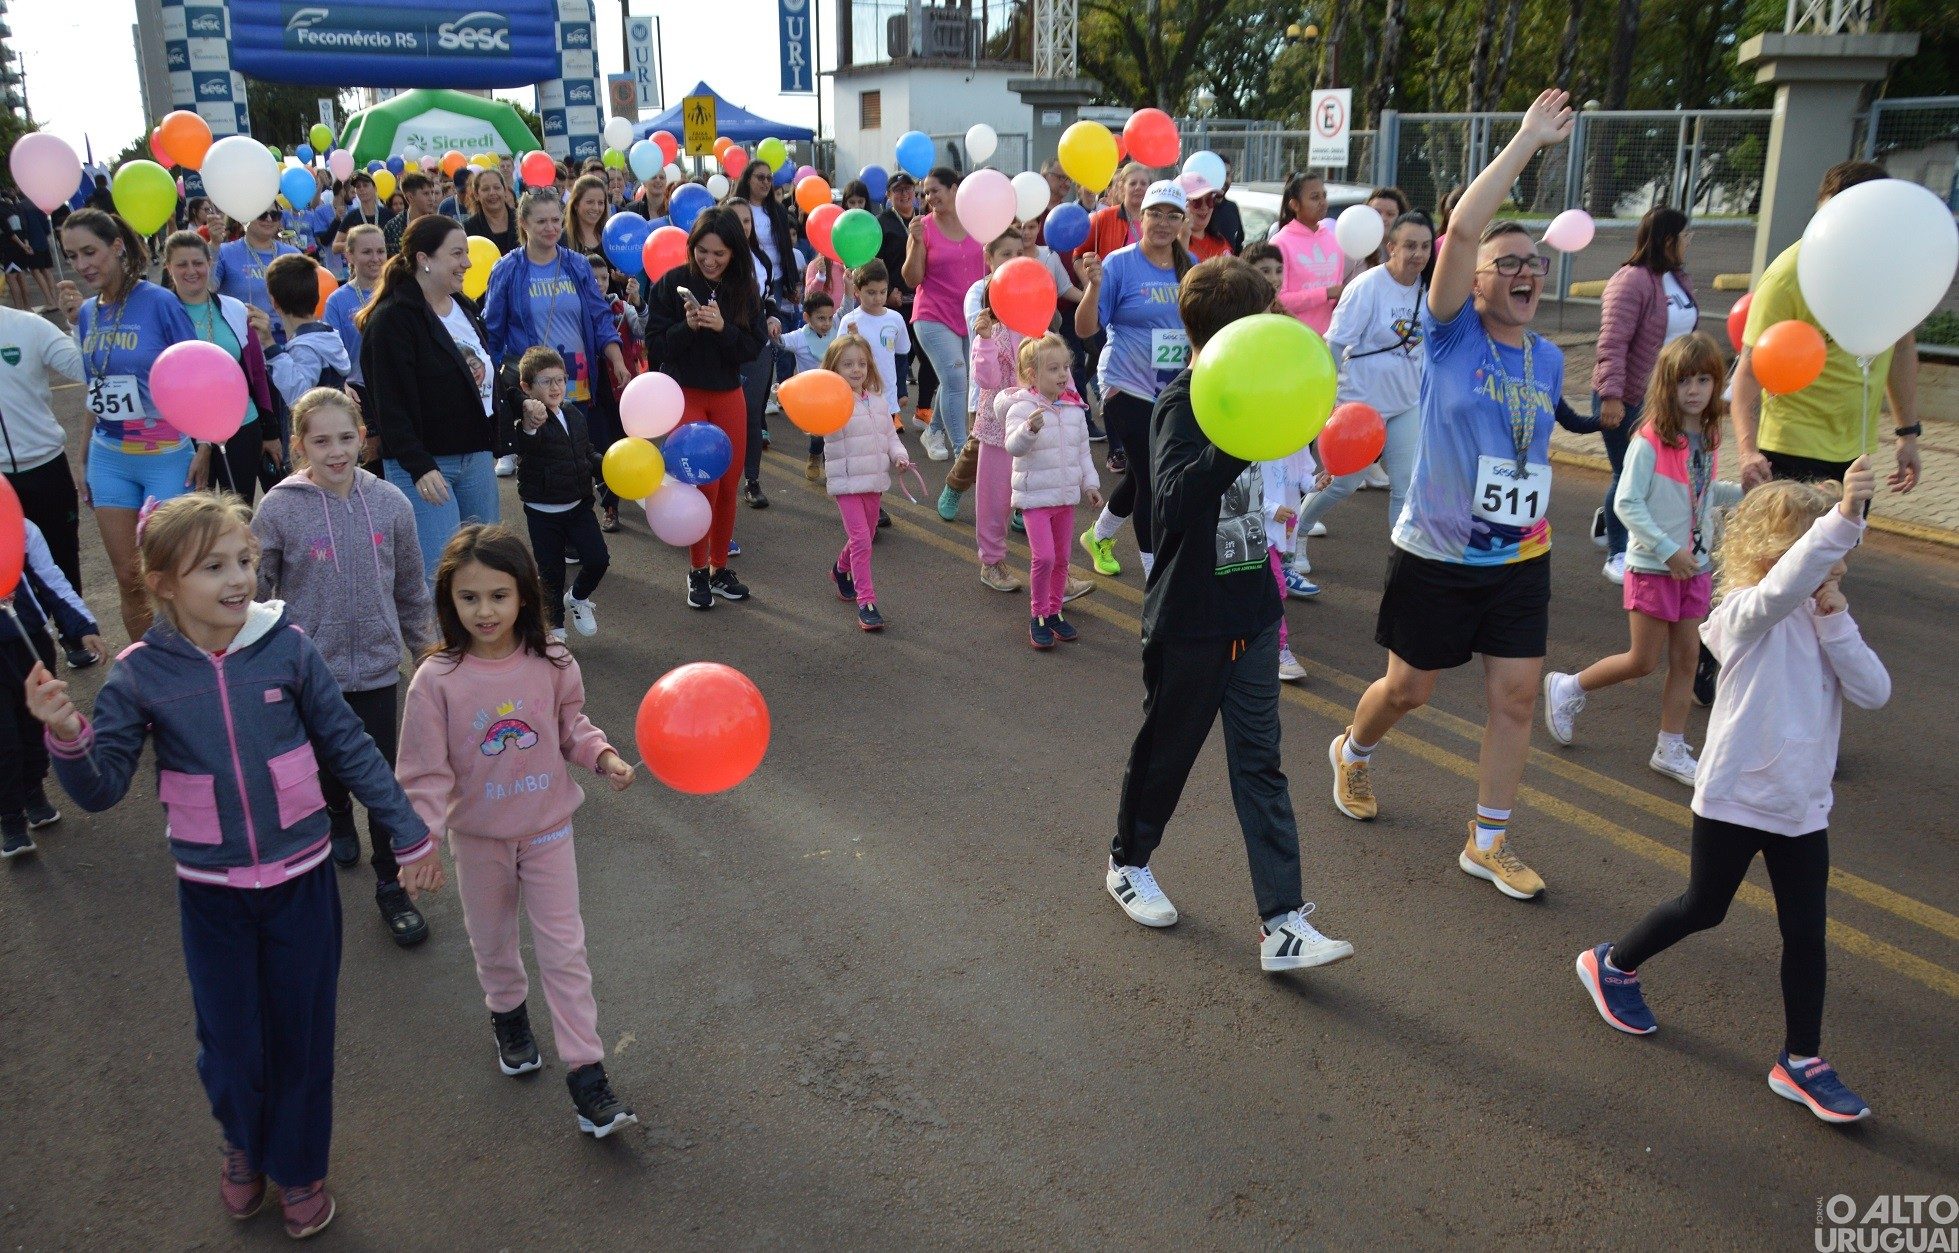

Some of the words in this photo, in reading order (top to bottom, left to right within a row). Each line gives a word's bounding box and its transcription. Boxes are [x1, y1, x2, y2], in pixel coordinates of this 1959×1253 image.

[298, 28, 391, 47] Fecomércio
[395, 32, 418, 49] RS
[438, 22, 510, 50] Sesc
[785, 15, 806, 90] URI
[634, 46, 652, 102] URI
[432, 133, 494, 150] Sicredi
[91, 393, 135, 415] 551
[1481, 483, 1539, 518] 511
